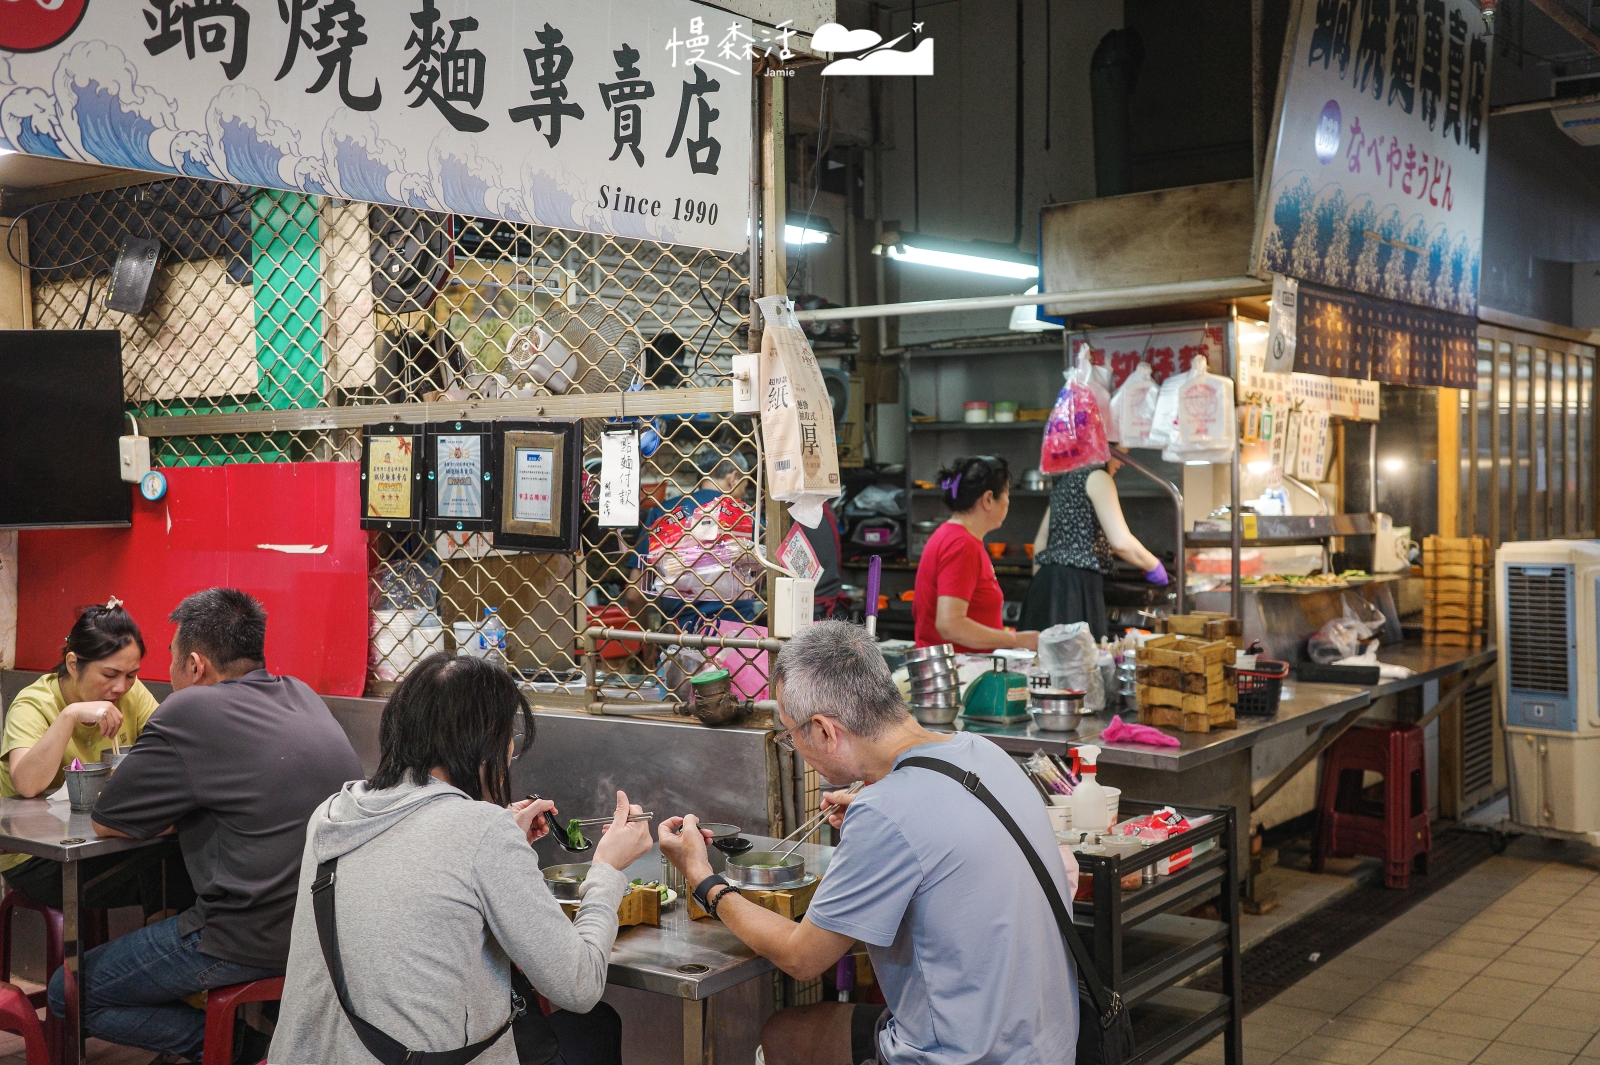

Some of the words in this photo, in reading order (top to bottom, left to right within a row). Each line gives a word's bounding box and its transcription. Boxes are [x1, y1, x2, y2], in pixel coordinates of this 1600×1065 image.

[143, 0, 723, 176] 鍋燒麵專賣店
[1346, 116, 1454, 212] なべやきうどん
[598, 184, 663, 215] Since
[673, 197, 719, 226] 1990
[768, 385, 789, 412] 紙
[801, 422, 819, 456] 厚
